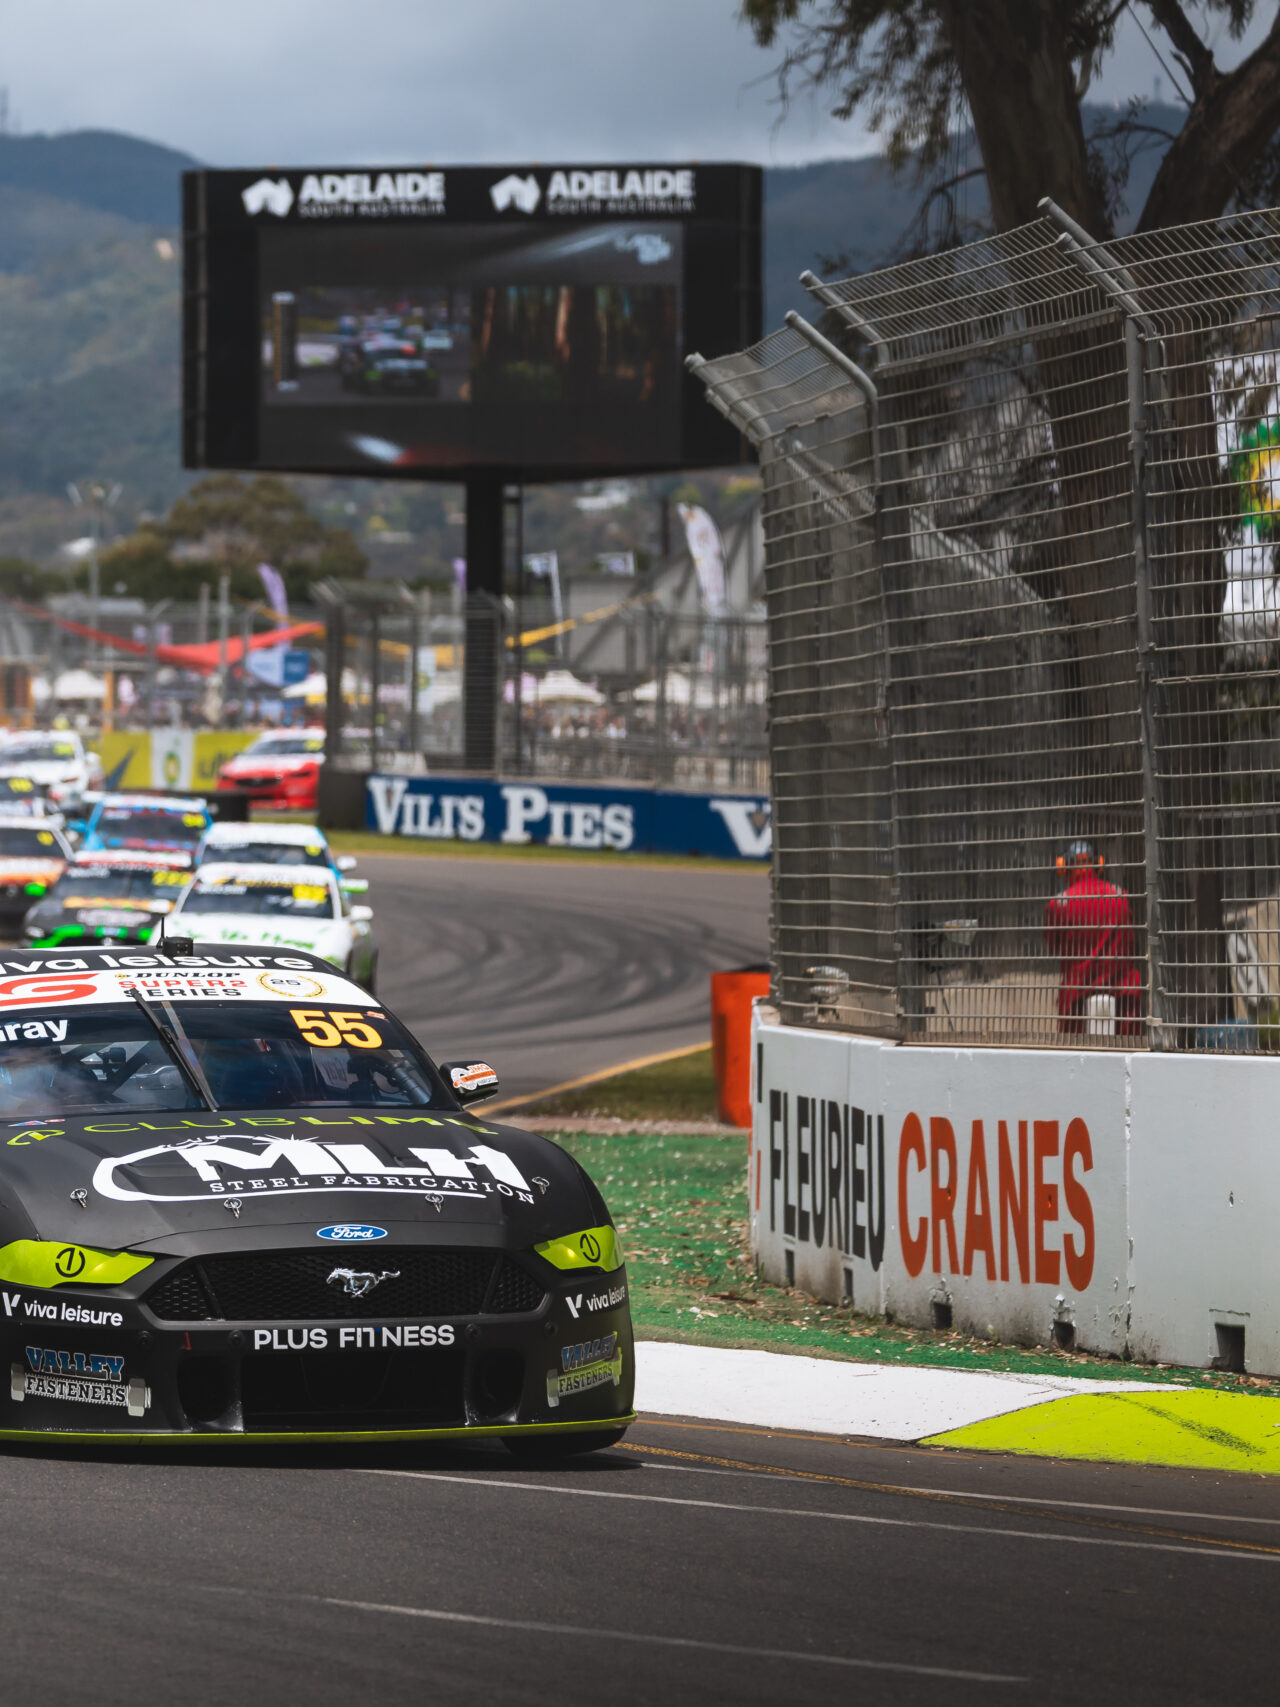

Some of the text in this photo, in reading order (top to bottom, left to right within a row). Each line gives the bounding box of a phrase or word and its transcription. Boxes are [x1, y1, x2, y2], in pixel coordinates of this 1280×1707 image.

[298, 173, 447, 202] ADELAIDE
[546, 170, 695, 200] ADELAIDE
[299, 202, 446, 217] SOUTH AUSTRALIA
[547, 198, 696, 214] SOUTH AUSTRALIA
[500, 786, 634, 850] PIES
[103, 953, 315, 971] leisure
[118, 979, 248, 989] SUPER2
[123, 988, 242, 998] SERIES
[289, 1010, 383, 1048] 55
[209, 1176, 535, 1204] STEEL FABRICATION
[769, 1088, 1096, 1292] FLEURIEU CRANES
[24, 1302, 124, 1327] viva leisure
[587, 1293, 609, 1311] viva
[254, 1325, 455, 1351] PLUS FITNESS
[26, 1346, 125, 1382] VALLEY
[561, 1333, 618, 1372] VALLEY
[25, 1376, 127, 1404] FASTENERS
[559, 1364, 613, 1393] FASTENERS
